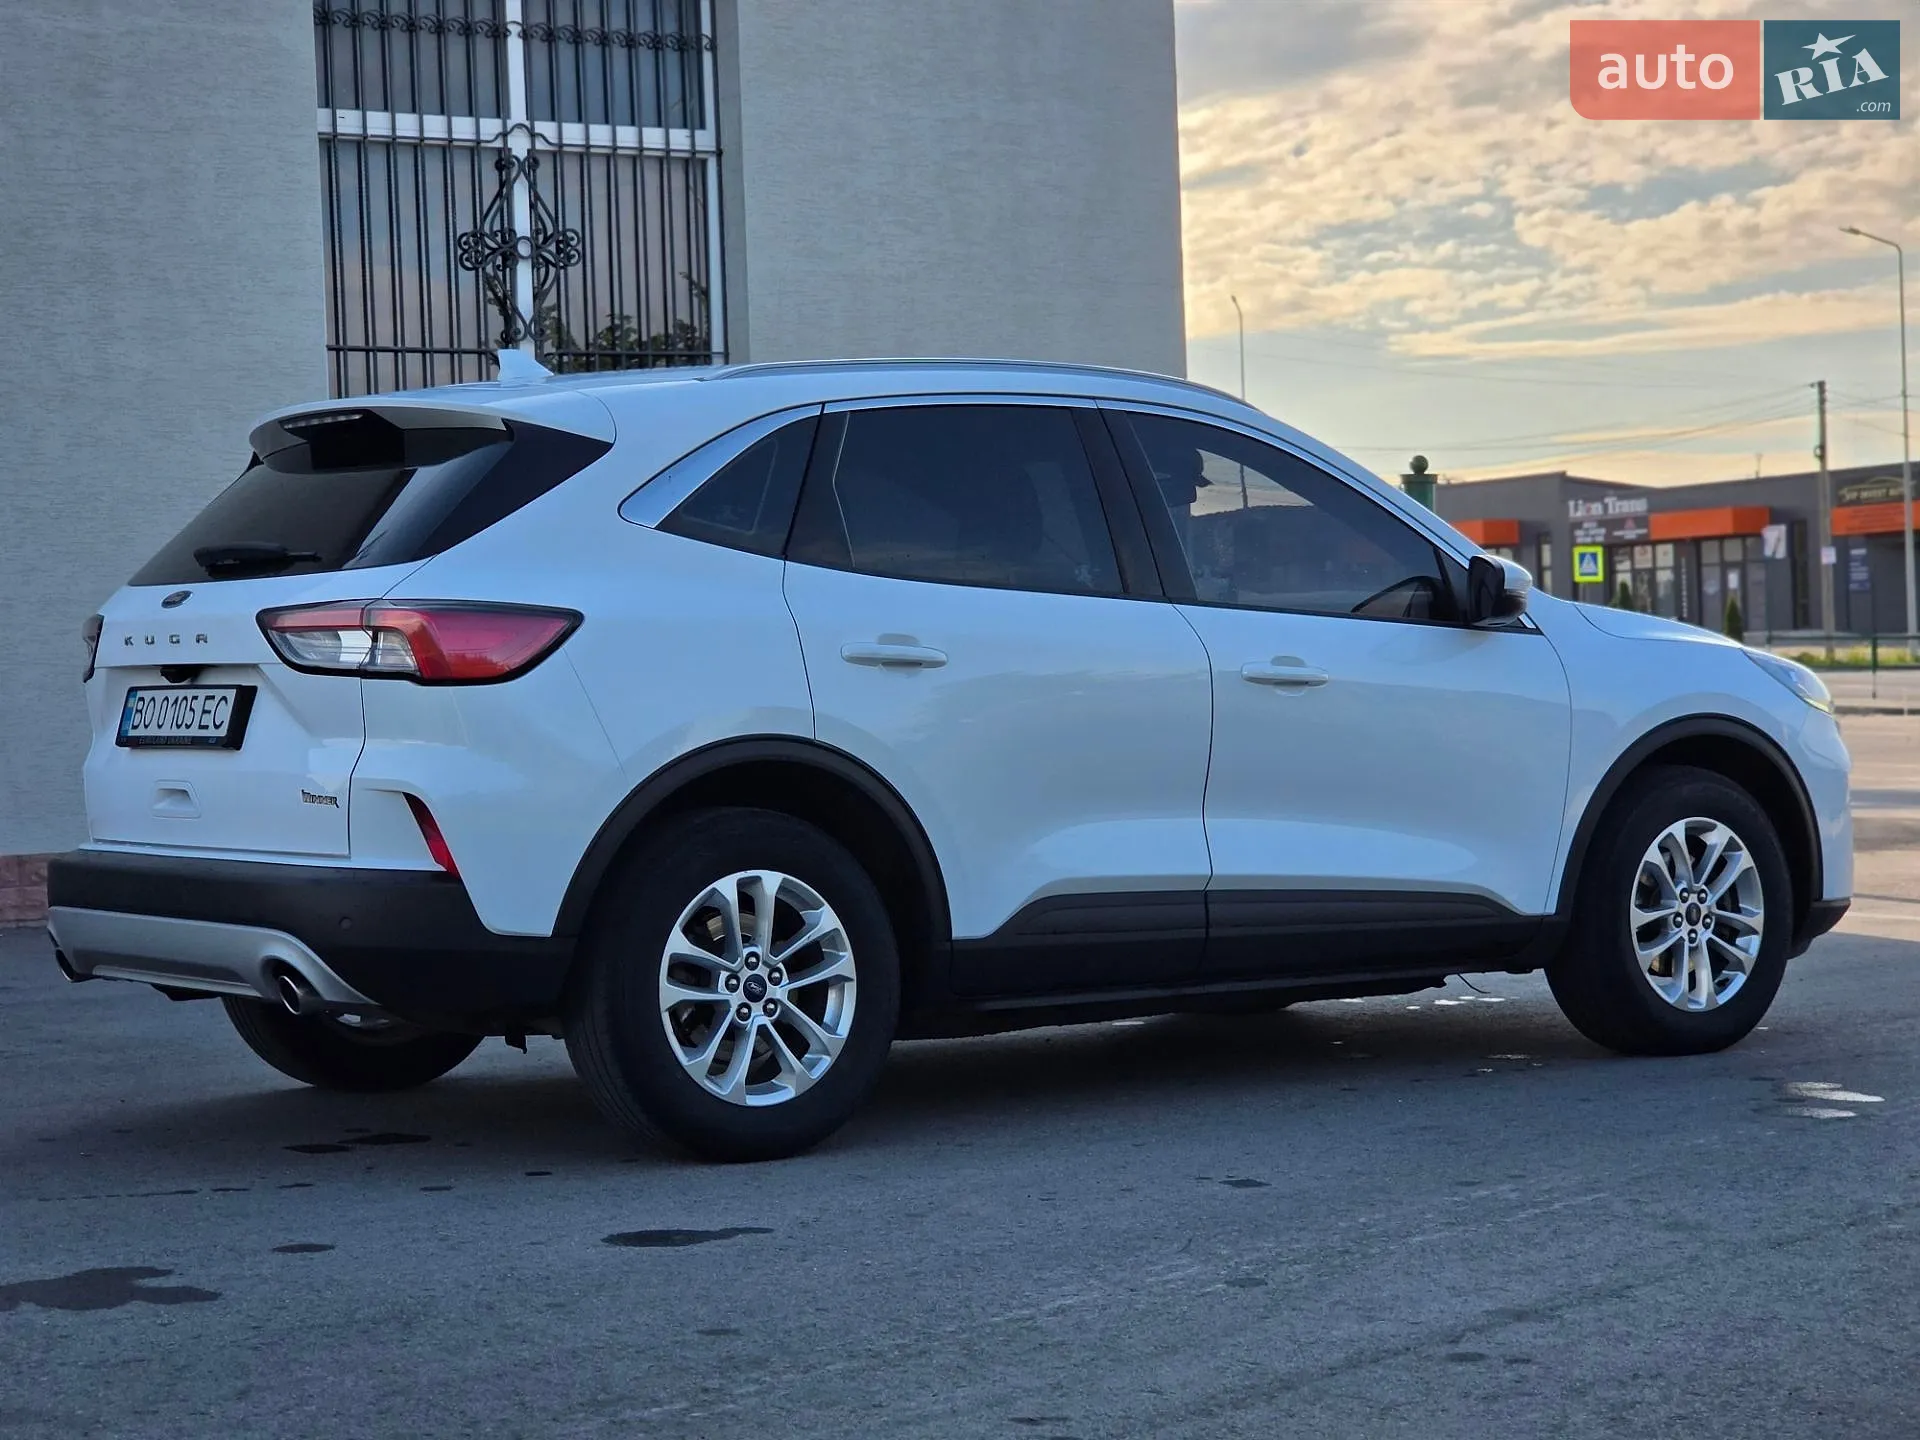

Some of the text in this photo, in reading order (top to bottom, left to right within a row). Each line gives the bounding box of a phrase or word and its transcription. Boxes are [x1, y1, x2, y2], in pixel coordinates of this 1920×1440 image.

[124, 633, 208, 647] KUGA
[131, 695, 228, 730] BO 0105 EC
